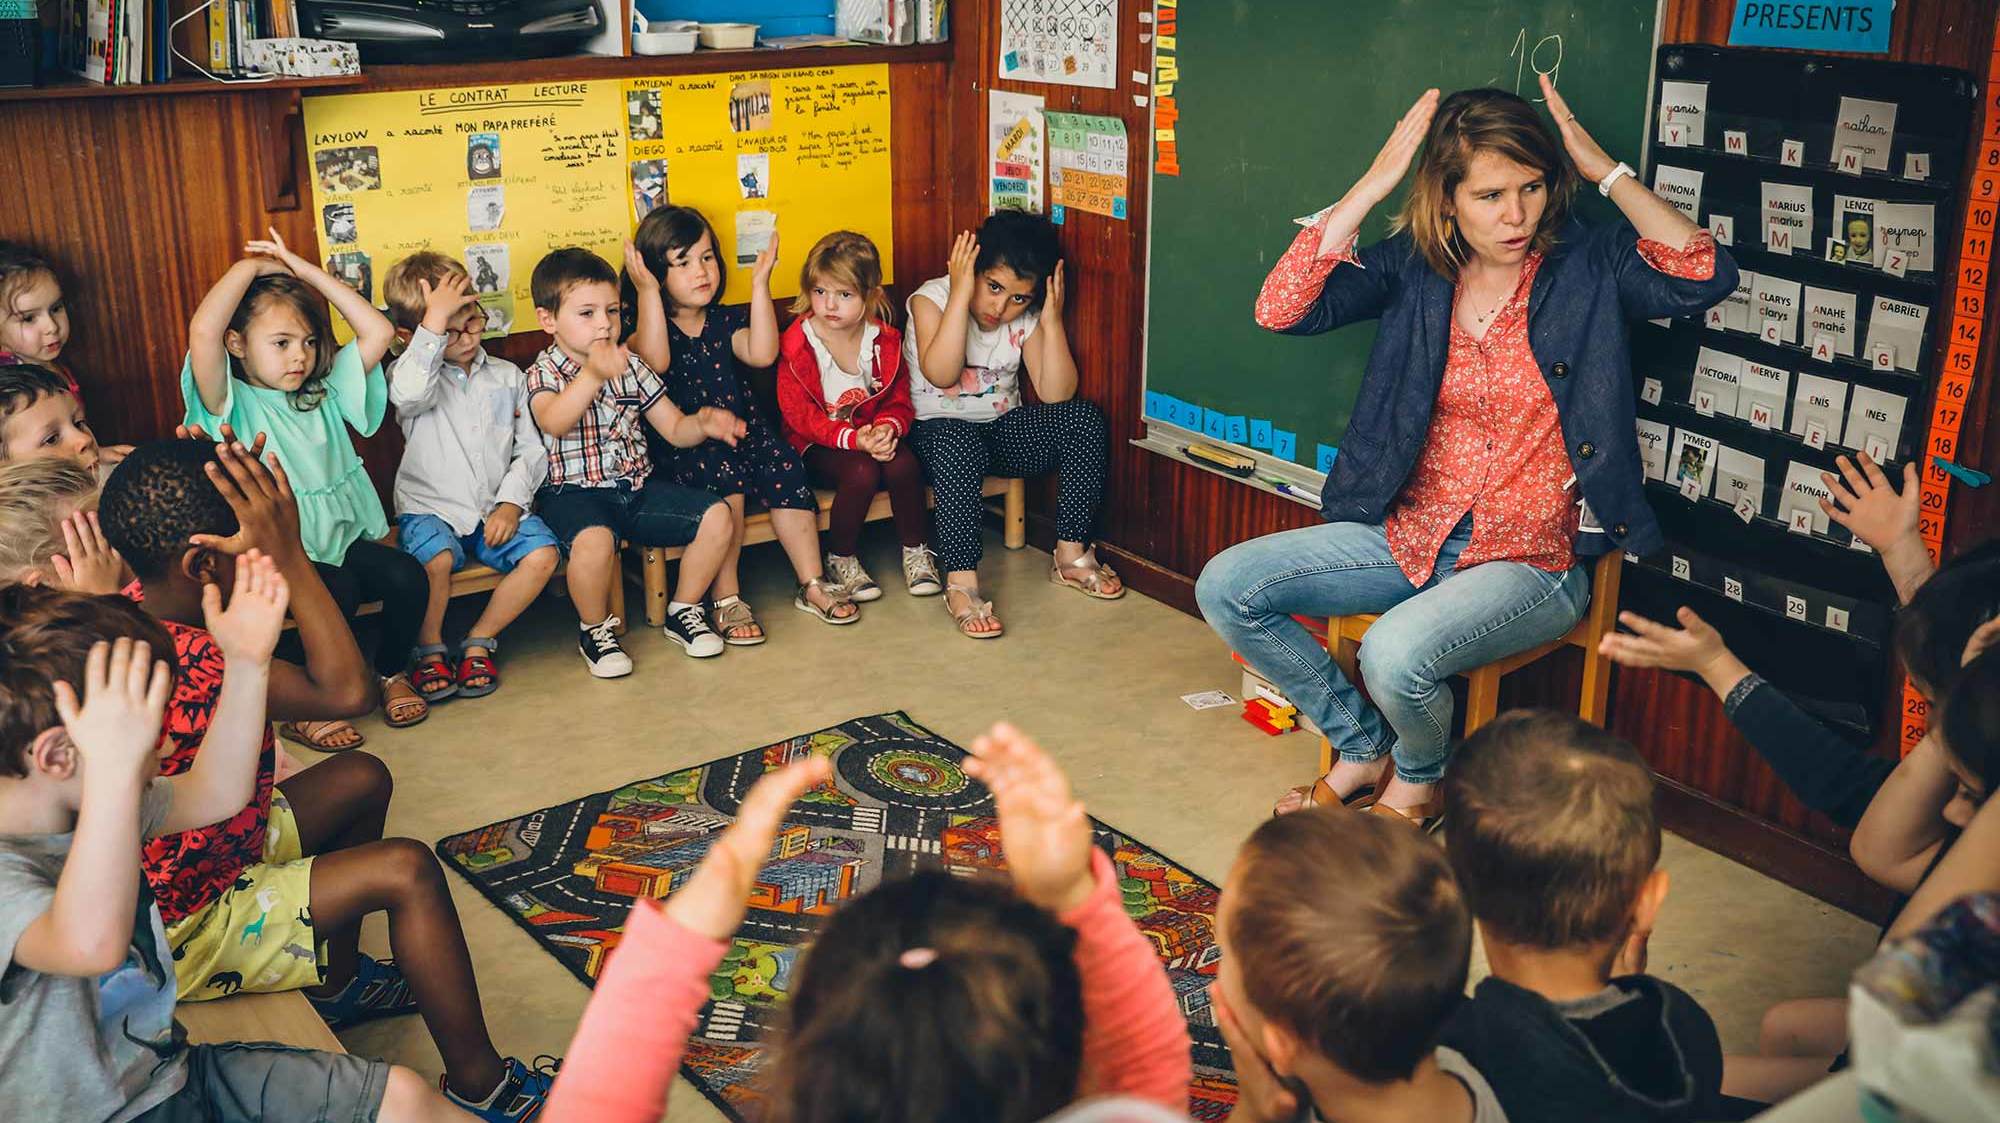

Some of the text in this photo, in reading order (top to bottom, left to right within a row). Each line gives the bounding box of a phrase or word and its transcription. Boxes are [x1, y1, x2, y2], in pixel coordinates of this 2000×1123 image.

[1743, 3, 1873, 33] PRESENTS
[1510, 28, 1562, 102] 19
[419, 83, 588, 107] LE CONTRAT LECTURE
[1666, 103, 1700, 122] yanis
[314, 129, 369, 146] LAYLOW
[403, 124, 444, 137] raconté
[455, 122, 477, 133] MON
[483, 120, 508, 131] PAPA
[1843, 114, 1888, 136] nathan
[1005, 127, 1024, 153] MARDI
[1064, 133, 1071, 144] 8
[1075, 132, 1081, 143] 9
[1089, 136, 1099, 148] 10
[1102, 139, 1111, 150] 11
[1115, 138, 1125, 150] 12
[1670, 130, 1679, 143] Y
[1728, 136, 1741, 149] M
[633, 144, 666, 155] DIEGO
[1787, 149, 1796, 162] K
[1077, 154, 1085, 165] 15
[1089, 156, 1097, 168] 16
[1116, 160, 1125, 172] 18
[1844, 155, 1856, 169] N
[1988, 150, 2000, 166] 8
[1915, 160, 1923, 173] L
[995, 180, 1026, 191] VENDREDI
[1089, 177, 1099, 188] 22
[1659, 182, 1696, 197] WINONA
[1982, 179, 1993, 196] 9
[1088, 194, 1099, 206] 28
[1768, 199, 1806, 213] MARIUS
[1769, 214, 1804, 228] marius
[1974, 209, 1991, 226] 10
[1715, 223, 1727, 239] A
[1880, 225, 1927, 247] zeynep
[1771, 230, 1788, 249] M
[1969, 239, 1986, 256] 11
[1890, 256, 1901, 270] Z
[1964, 268, 1983, 285] 12
[1759, 291, 1791, 307] CLARYS
[1961, 297, 1980, 314] 13
[1711, 312, 1721, 323] A
[1759, 306, 1788, 321] clarys
[1880, 301, 1921, 319] GABRIEL
[1767, 327, 1776, 339] C
[1812, 320, 1846, 334] anahé
[1958, 324, 1976, 342] 14
[1817, 344, 1828, 357] A
[1878, 353, 1889, 366] G
[1953, 352, 1971, 370] 15
[1700, 365, 1738, 385] VICTORIA
[1751, 365, 1781, 381] MERVE
[1648, 387, 1657, 399] T
[1946, 381, 1964, 398] 16
[1700, 397, 1709, 409] V
[1809, 394, 1830, 408] ENIS
[1753, 409, 1767, 424] M
[1939, 409, 1957, 427] 17
[1152, 400, 1333, 469] 1 2 3 4 5 6 7 9
[1811, 431, 1820, 444] E
[1873, 446, 1878, 458] I
[1934, 437, 1952, 454] 18
[1929, 464, 1947, 482] 19
[1688, 483, 1696, 495] T
[1791, 481, 1829, 499] KAYNAH
[1922, 491, 1943, 509] 20
[1739, 504, 1750, 516] Z
[1797, 515, 1806, 528] K
[1920, 519, 1939, 537] 21
[1674, 561, 1688, 574] 27
[1726, 582, 1740, 596] 28
[1789, 600, 1805, 615] 29
[1834, 614, 1842, 626] L
[1907, 698, 1926, 716] 28
